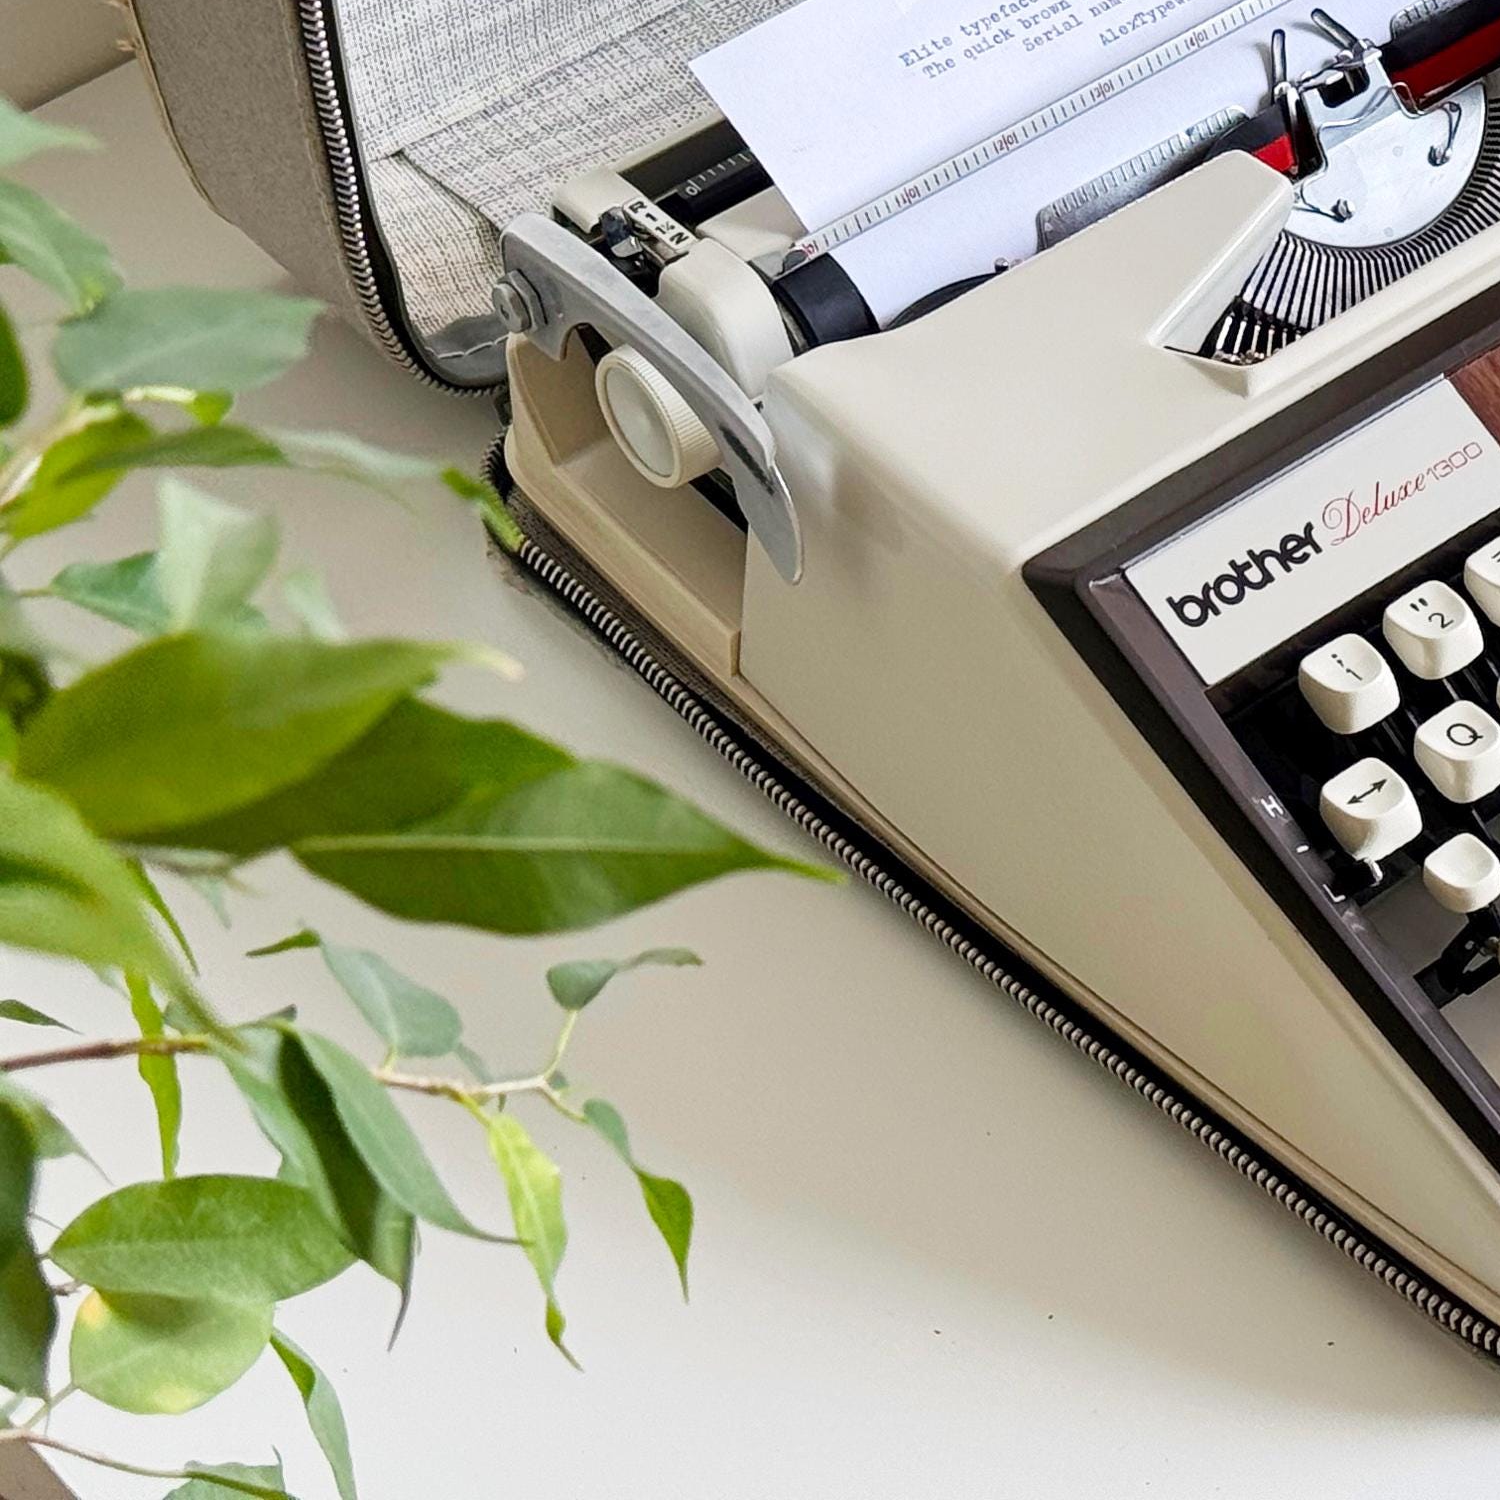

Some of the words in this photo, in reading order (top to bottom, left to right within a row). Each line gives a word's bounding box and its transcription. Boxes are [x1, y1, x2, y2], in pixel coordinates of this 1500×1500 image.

[922, 57, 956, 79] The
[963, 28, 1015, 60] quick
[1017, 0, 1072, 30] brown
[1022, 13, 1083, 52] Serial
[899, 35, 953, 67] Elite
[1166, 521, 1324, 627] brother
[1322, 473, 1427, 547] Deluxe
[1426, 441, 1484, 481] 1300
[1428, 612, 1453, 628] 2
[1346, 668, 1363, 680] 1
[1446, 723, 1483, 746] Q
